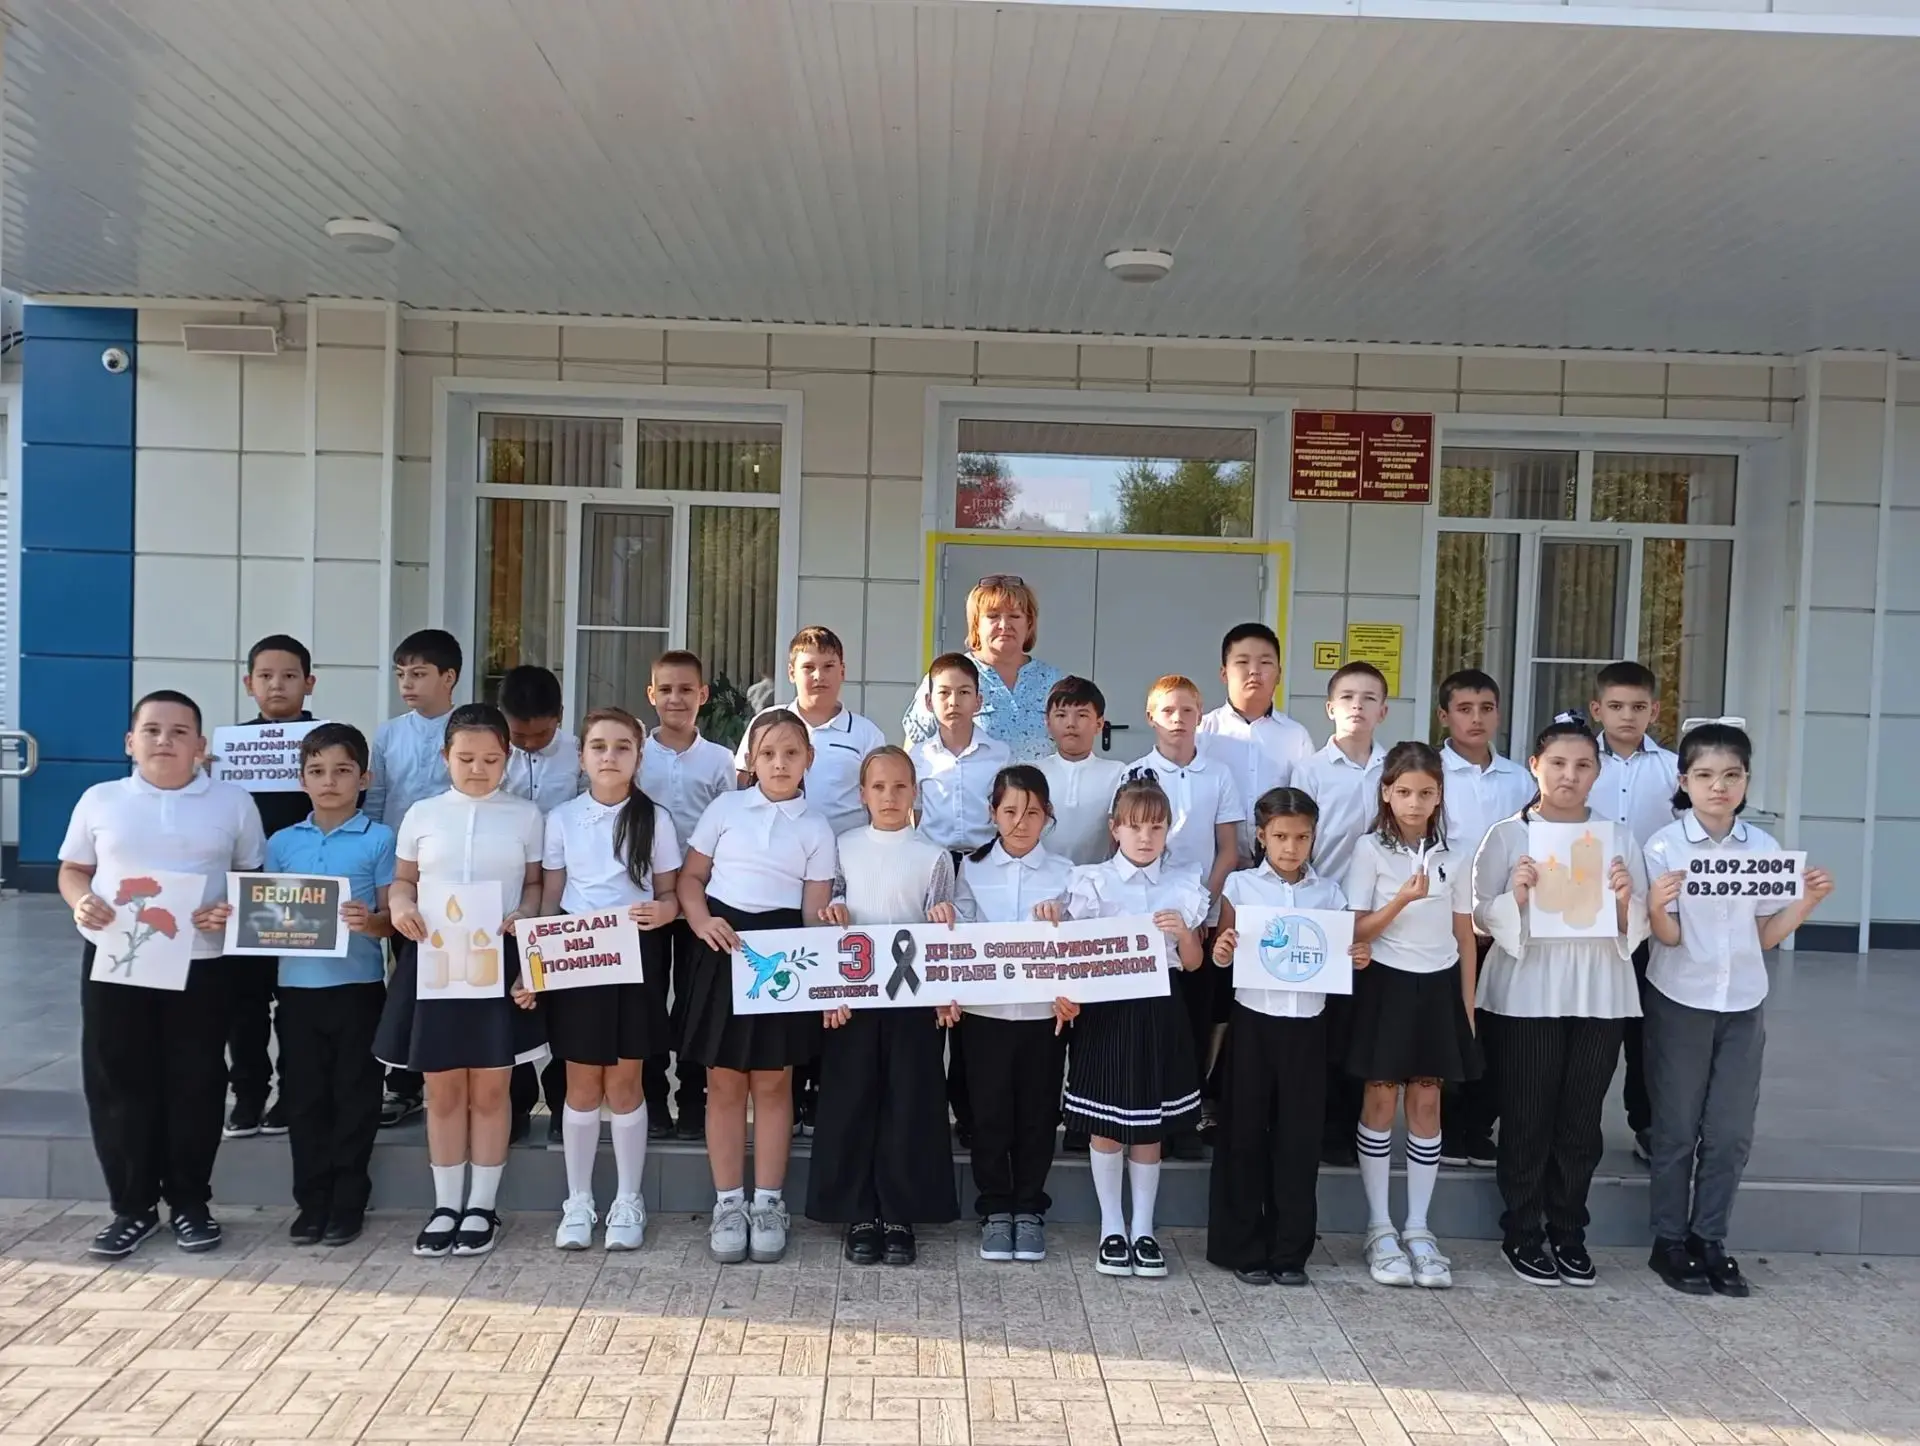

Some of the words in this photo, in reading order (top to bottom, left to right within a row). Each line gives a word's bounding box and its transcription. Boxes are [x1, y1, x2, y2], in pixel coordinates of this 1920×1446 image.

[260, 729, 283, 738] МЫ
[225, 740, 304, 752] ЗАПОМНИ
[229, 754, 283, 765] ЧТОБЫ
[221, 768, 301, 781] ПОВТОРИ
[1690, 859, 1795, 874] 01.09.2004
[252, 885, 326, 904] БЕСЛАН
[1687, 881, 1796, 896] 03.09.2004
[536, 915, 617, 937] БЕСЛАН
[564, 936, 594, 952] МЫ
[983, 936, 1129, 960] СОЛИДАРНОСТИ
[1136, 934, 1150, 951] В
[542, 952, 621, 973] ПОМНИМ
[838, 931, 875, 983] 3
[1290, 951, 1323, 965] НЕТ!
[1003, 963, 1016, 979] С
[1022, 955, 1157, 980] ТЕРРОРИЗМОМ
[808, 984, 879, 1000] СЕНТЯБРЯ
